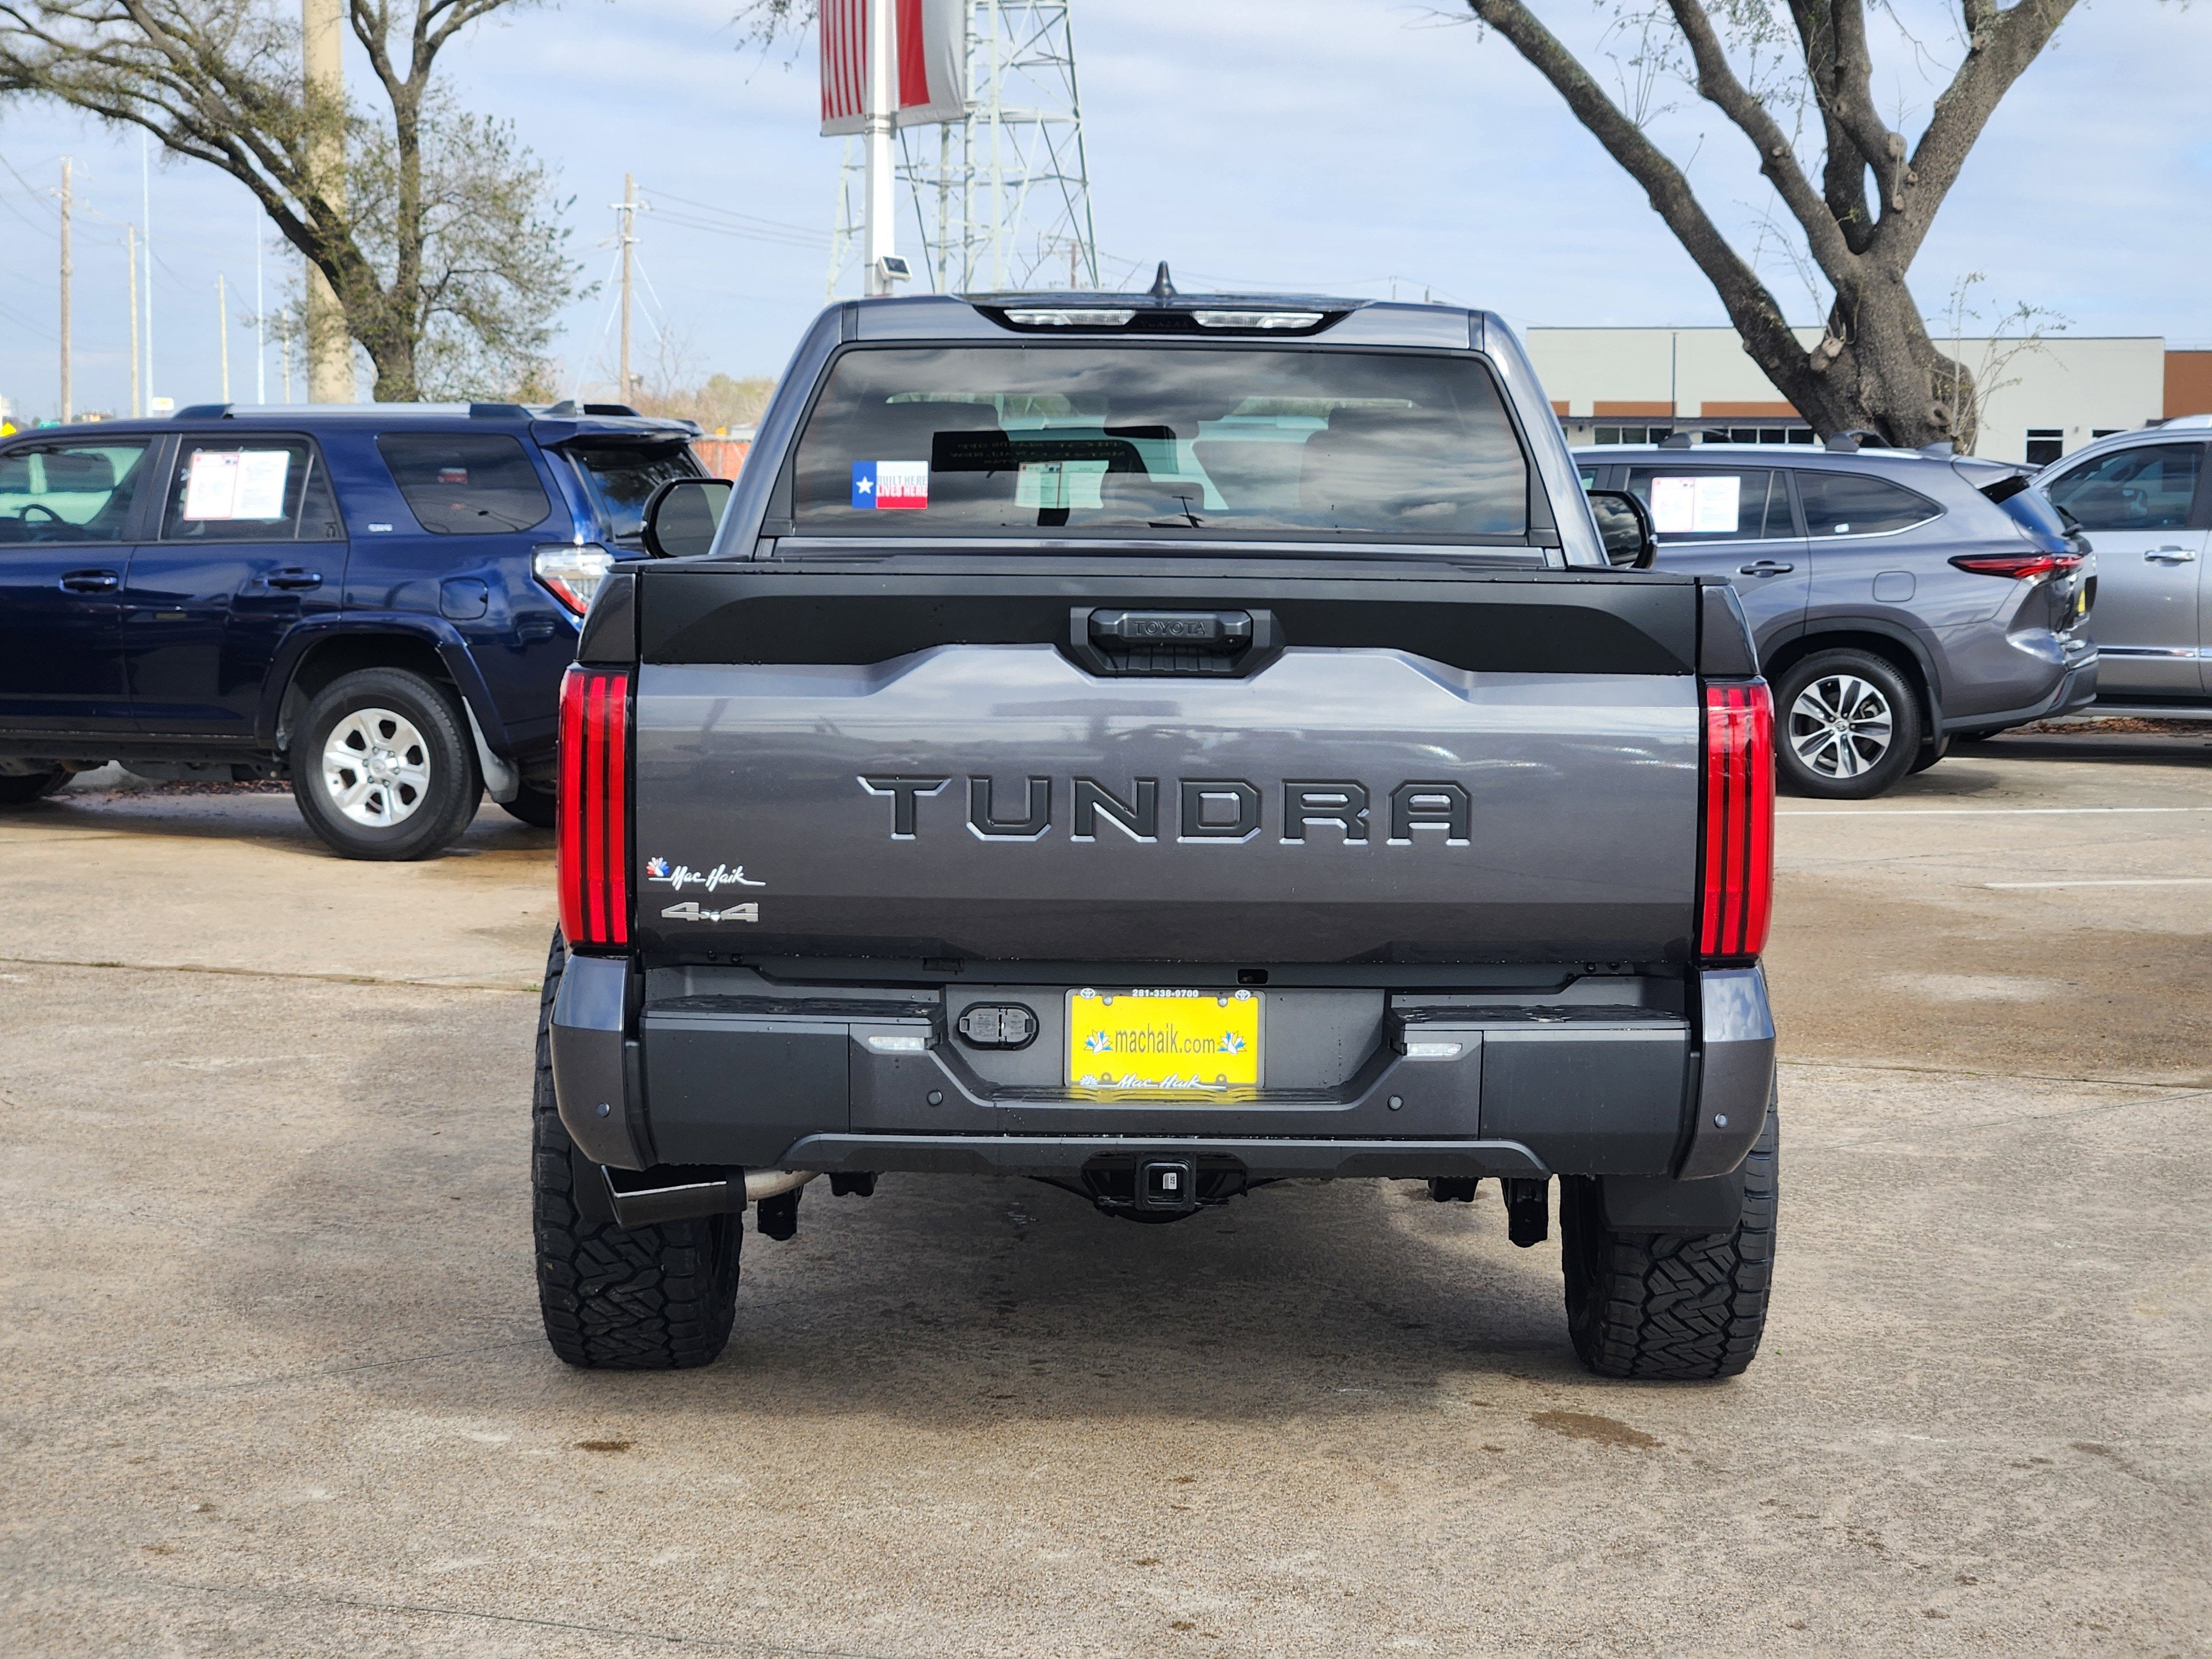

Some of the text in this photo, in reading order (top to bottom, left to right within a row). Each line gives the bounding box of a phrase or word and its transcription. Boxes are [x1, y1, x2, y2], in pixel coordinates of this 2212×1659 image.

[878, 475, 928, 485] BUILT HERE
[877, 484, 928, 496] LIVES HERE
[1134, 621, 1207, 636] TOYOTA
[857, 775, 1472, 846] TUNDRA
[664, 863, 758, 892] Mac Haik
[1115, 1023, 1215, 1053] machaik.com
[1112, 1072, 1158, 1089] Mac
